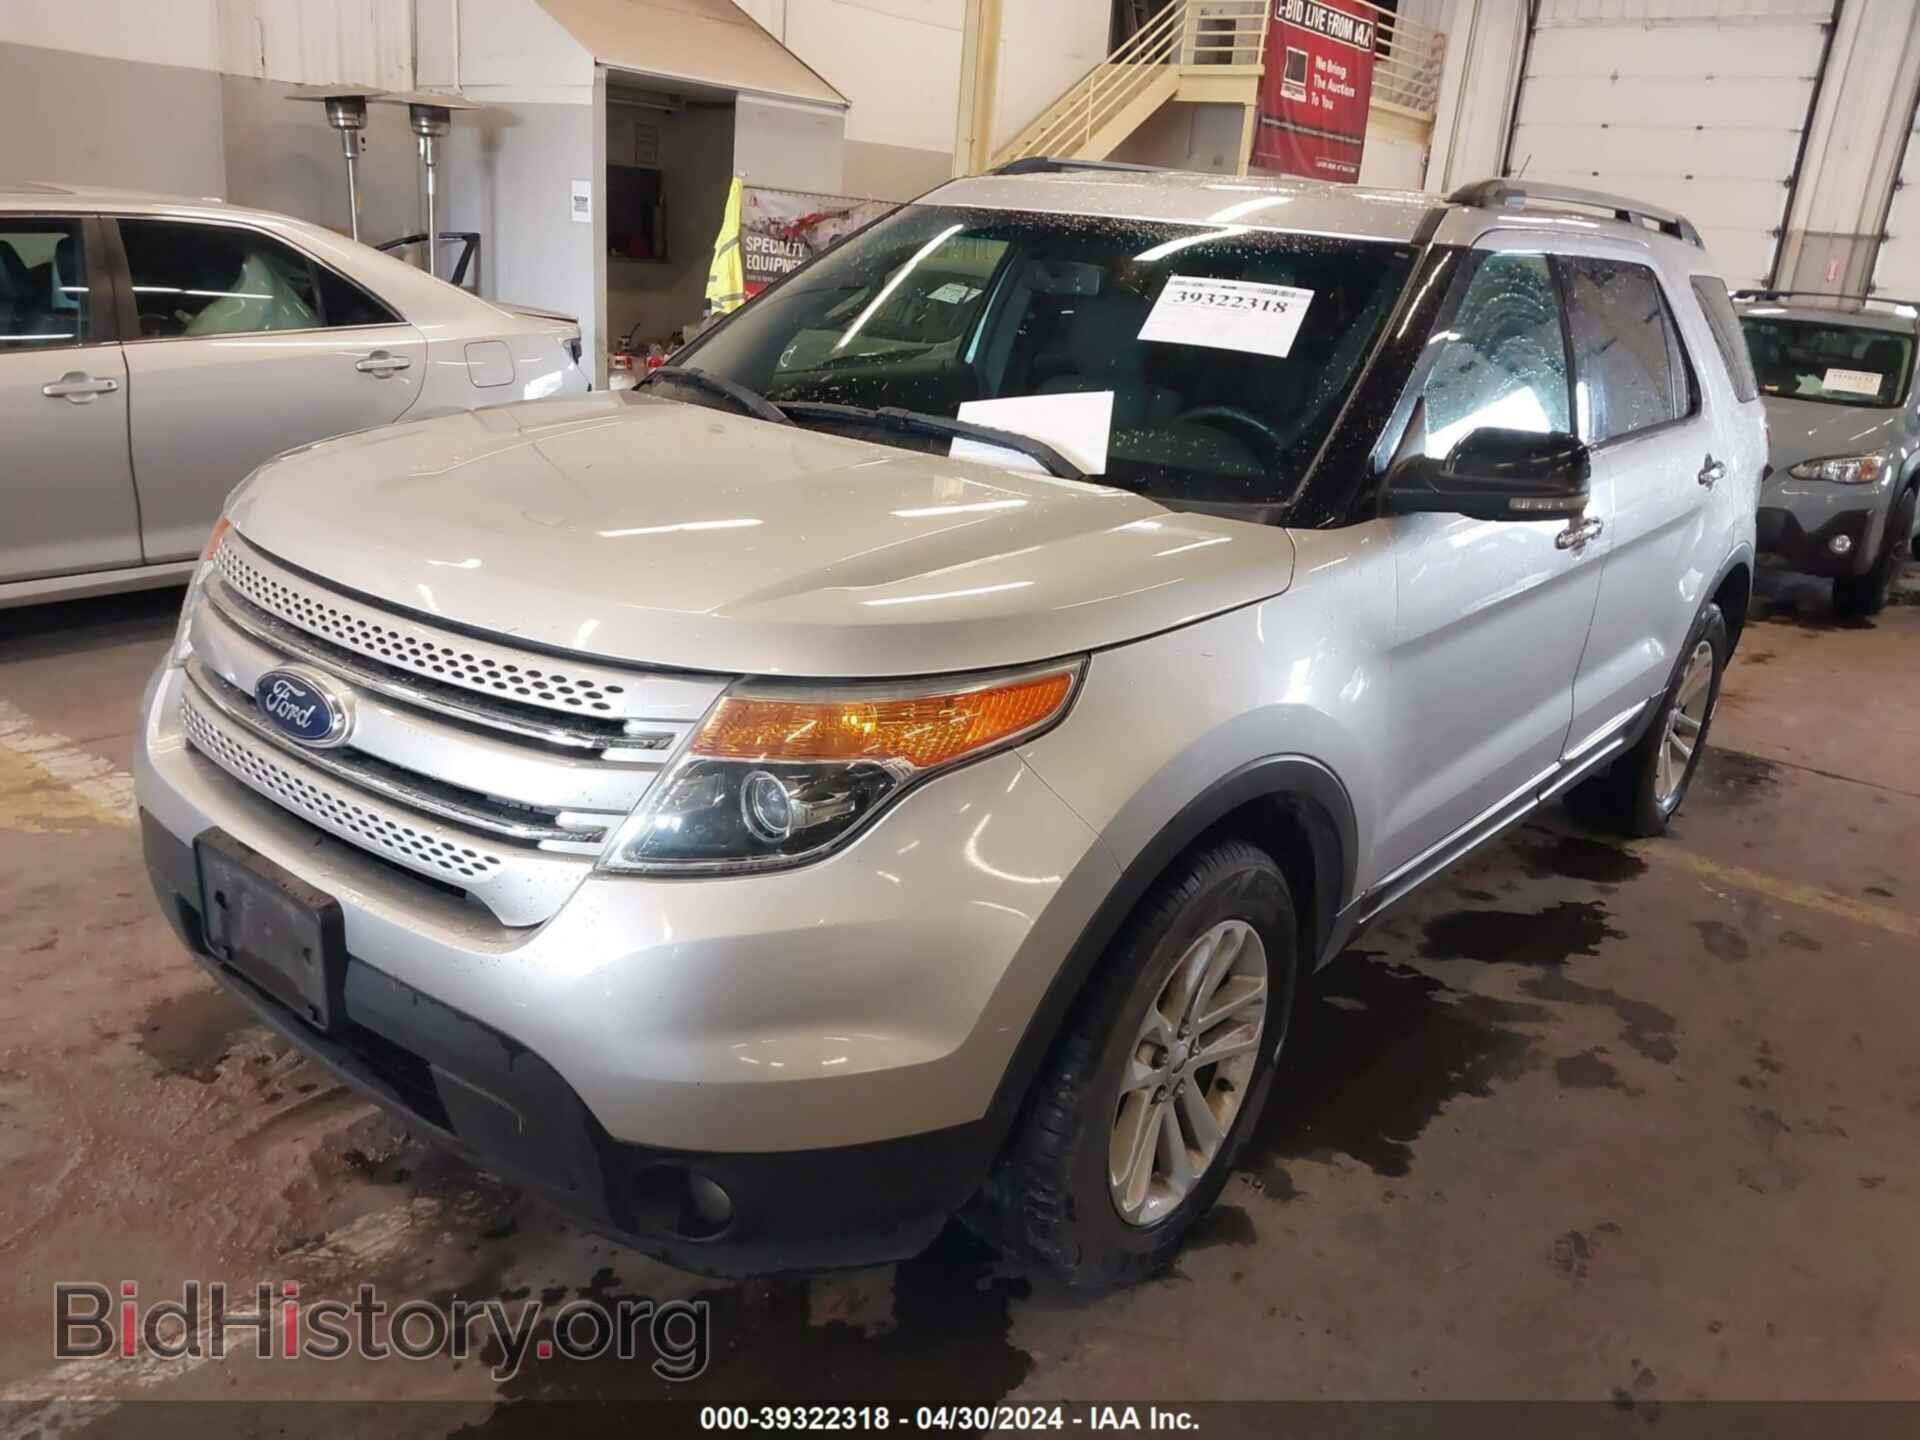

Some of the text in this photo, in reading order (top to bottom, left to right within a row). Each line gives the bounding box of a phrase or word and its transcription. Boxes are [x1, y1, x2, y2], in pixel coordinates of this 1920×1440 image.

[1304, 3, 1327, 31] LIVE
[1326, 12, 1355, 41] FROM
[1315, 55, 1347, 80] We Bring
[1313, 73, 1356, 98] The Auction
[1311, 91, 1334, 110] To You
[745, 236, 805, 257] SPECIALTY
[1173, 290, 1289, 314] 39322318
[265, 679, 317, 728] Ford
